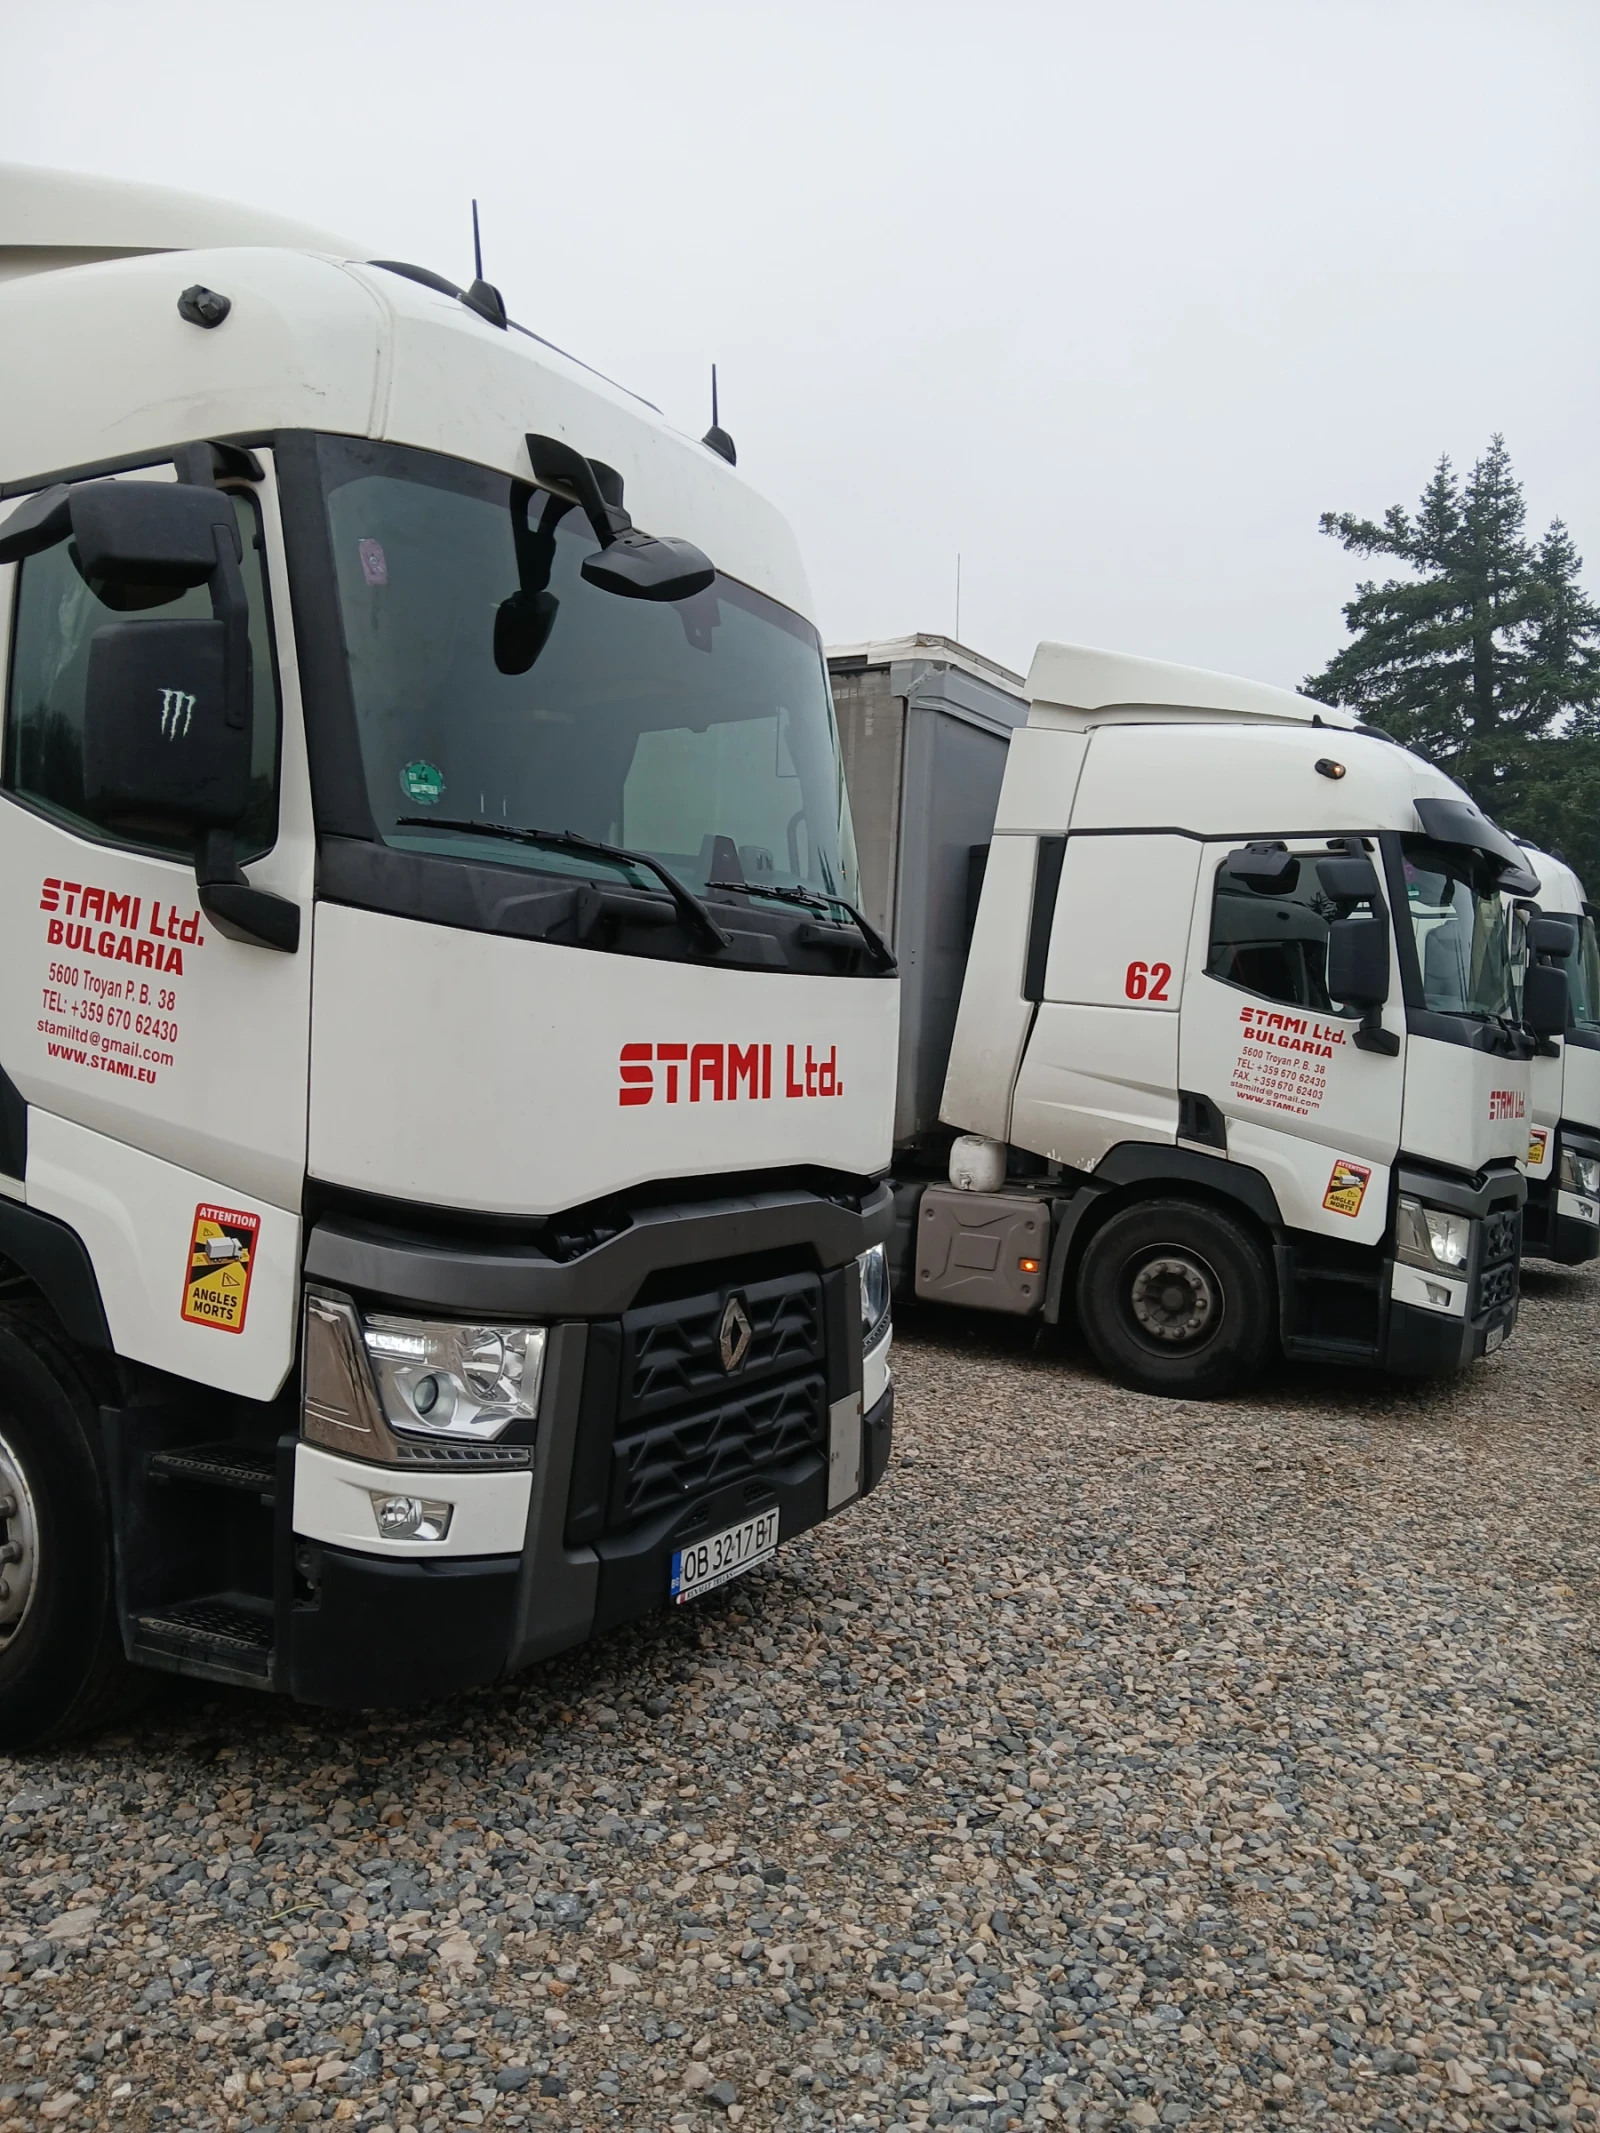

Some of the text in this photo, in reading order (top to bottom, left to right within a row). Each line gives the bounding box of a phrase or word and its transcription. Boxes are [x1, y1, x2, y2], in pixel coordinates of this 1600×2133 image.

[40, 878, 204, 946] STAMI Ltd.
[46, 918, 184, 976] BULGARIA
[48, 962, 176, 1012] 5600 Troyan P. B. 38
[1125, 961, 1171, 1001] 62
[42, 988, 178, 1043] TEL: +359 670 62430
[1239, 1006, 1347, 1045] STAMI Ltd.
[36, 1018, 174, 1067] stamiltd@gmail.com
[1243, 1027, 1332, 1058] BULGARIA
[619, 1043, 843, 1106] STAMI Ltd.
[1242, 1046, 1263, 1059] 5600
[1266, 1052, 1291, 1066] Troyan
[1314, 1064, 1326, 1074] 38
[1254, 1076, 1276, 1088] +359
[1277, 1081, 1294, 1092] 670
[1296, 1085, 1324, 1100] 62403
[1257, 1064, 1279, 1075] +359
[1280, 1069, 1297, 1080] 670
[1299, 1073, 1326, 1088] 62430
[1230, 1081, 1320, 1109] stamiltd@gmail.com
[1489, 1091, 1514, 1120] STAMI
[1338, 1161, 1369, 1174] ATTENTION
[1330, 1194, 1355, 1206] ANGLES
[1330, 1200, 1353, 1211] MORTS
[199, 1207, 257, 1228] ATTENTION
[192, 1287, 238, 1308] ANGLES
[193, 1300, 234, 1321] MORTS
[684, 1545, 708, 1582] OB
[713, 1523, 753, 1571] 3217
[756, 1512, 776, 1550] BT
